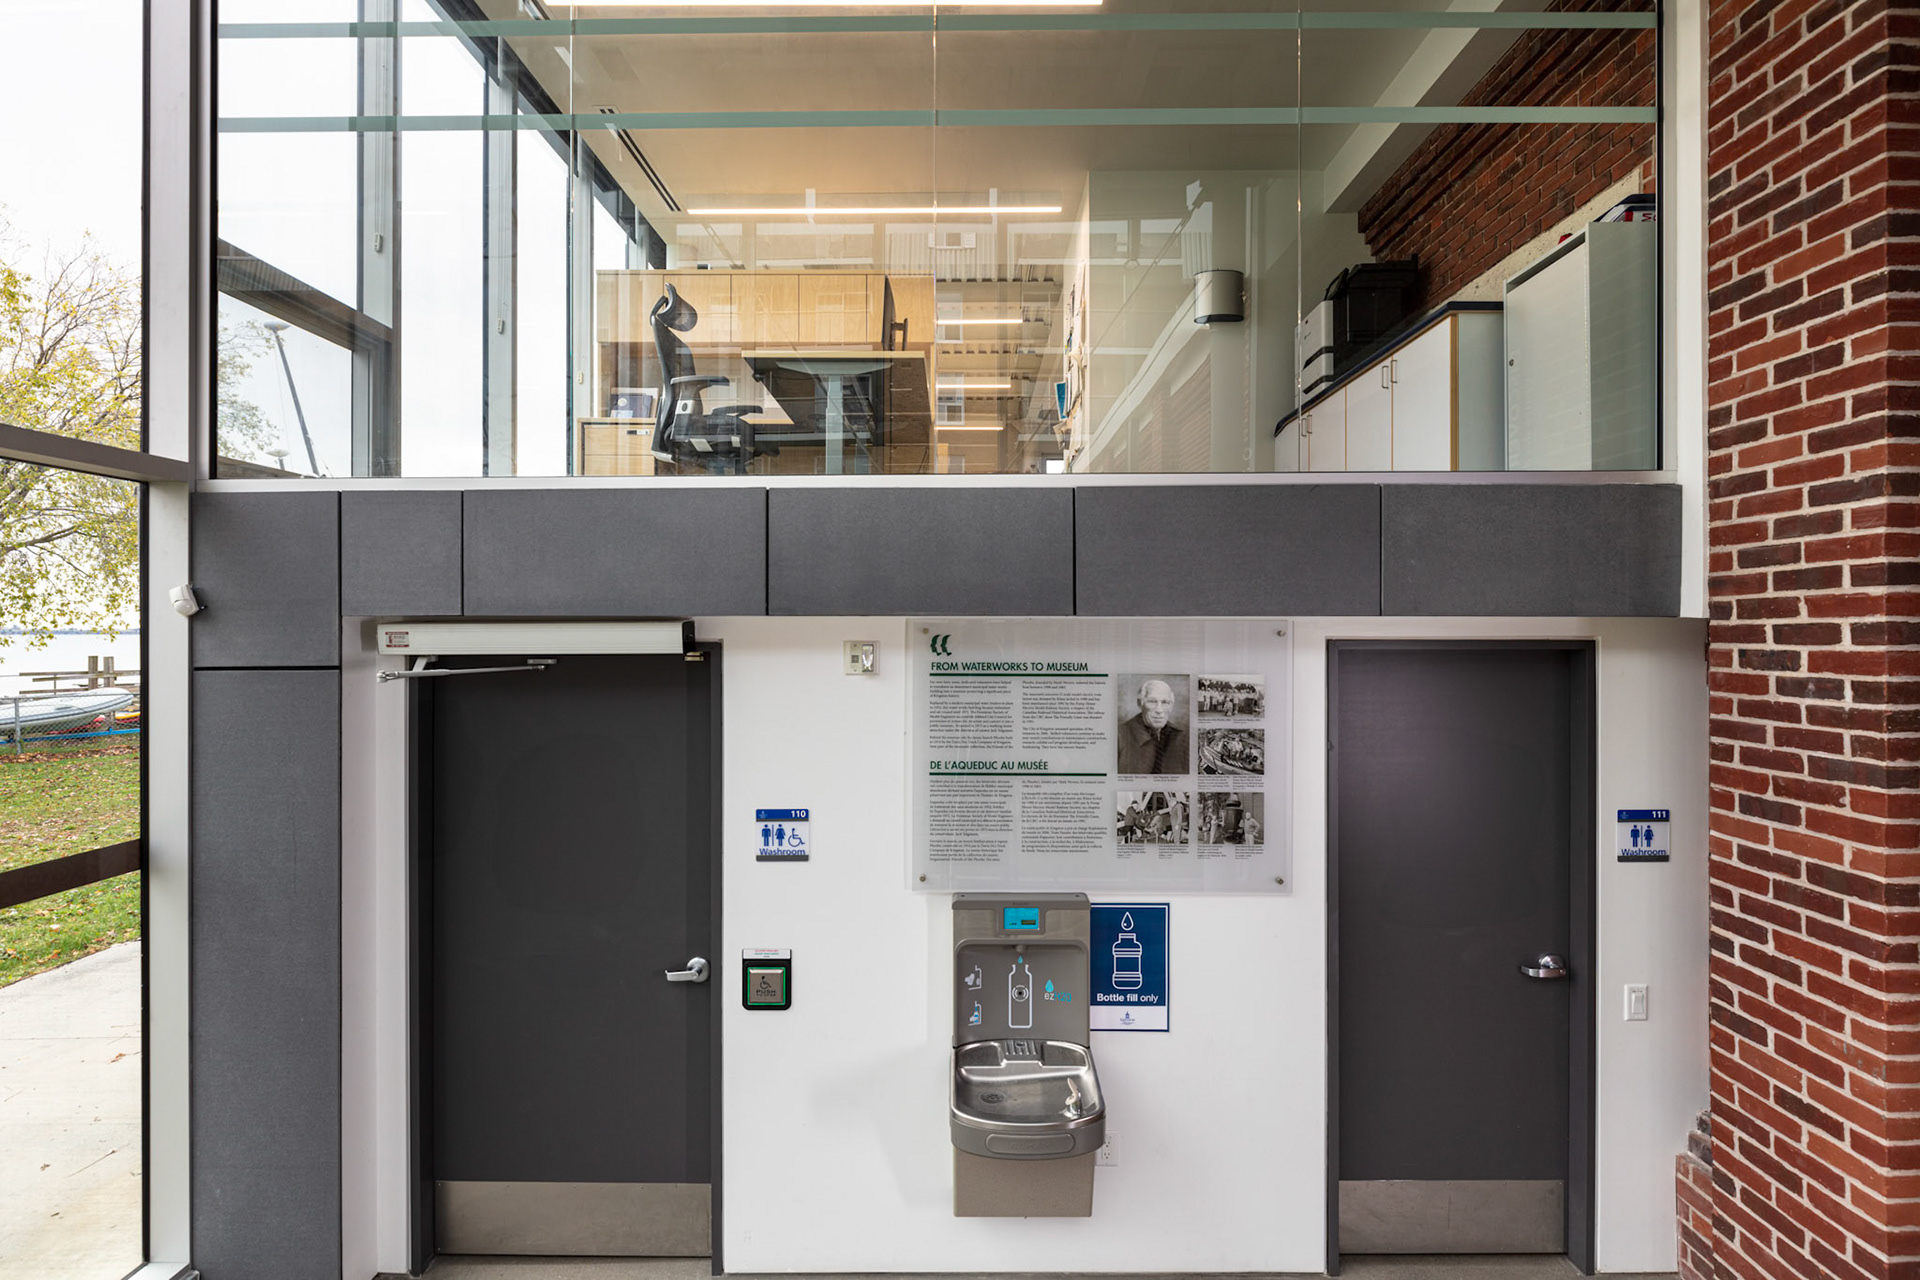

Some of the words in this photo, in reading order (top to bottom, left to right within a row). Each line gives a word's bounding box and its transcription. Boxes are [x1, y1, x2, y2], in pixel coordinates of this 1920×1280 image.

[931, 662, 958, 671] FROM
[961, 662, 1028, 671] WATERWORKS
[1031, 662, 1044, 671] TO
[1046, 662, 1088, 671] MUSEUM
[930, 761, 942, 770] DE
[944, 760, 998, 771] L'AQUEDUC
[1000, 761, 1015, 770] AU
[1017, 758, 1049, 770] MUSÉE
[791, 810, 806, 818] 110
[759, 848, 805, 856] Washroom
[1621, 848, 1667, 856] Washroom
[1096, 993, 1125, 1002] Bottle
[1126, 993, 1138, 1002] fill
[1140, 994, 1159, 1004] only
